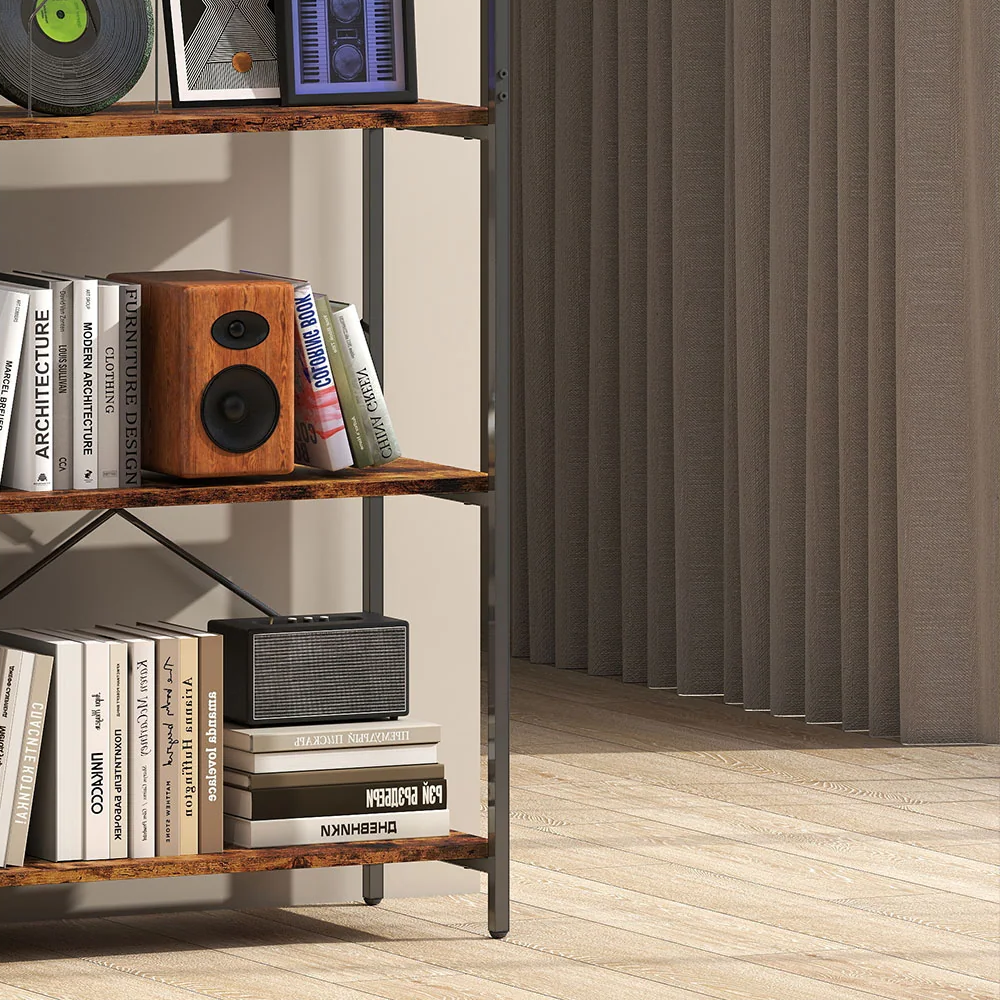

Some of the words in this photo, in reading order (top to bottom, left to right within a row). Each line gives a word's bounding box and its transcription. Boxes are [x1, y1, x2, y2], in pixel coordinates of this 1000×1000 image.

[58, 344, 67, 364] LOUIS
[83, 322, 92, 369] MODERN
[126, 288, 138, 406] FURNITURE
[0, 360, 13, 395] MARCEL
[35, 309, 50, 460] ARCHITECTURE
[58, 364, 67, 394] SULLIVAN
[105, 346, 114, 414] CLOTHING
[83, 372, 92, 456] ARCHITECTURE
[58, 457, 67, 472] CCA
[126, 412, 138, 486] DESIGN
